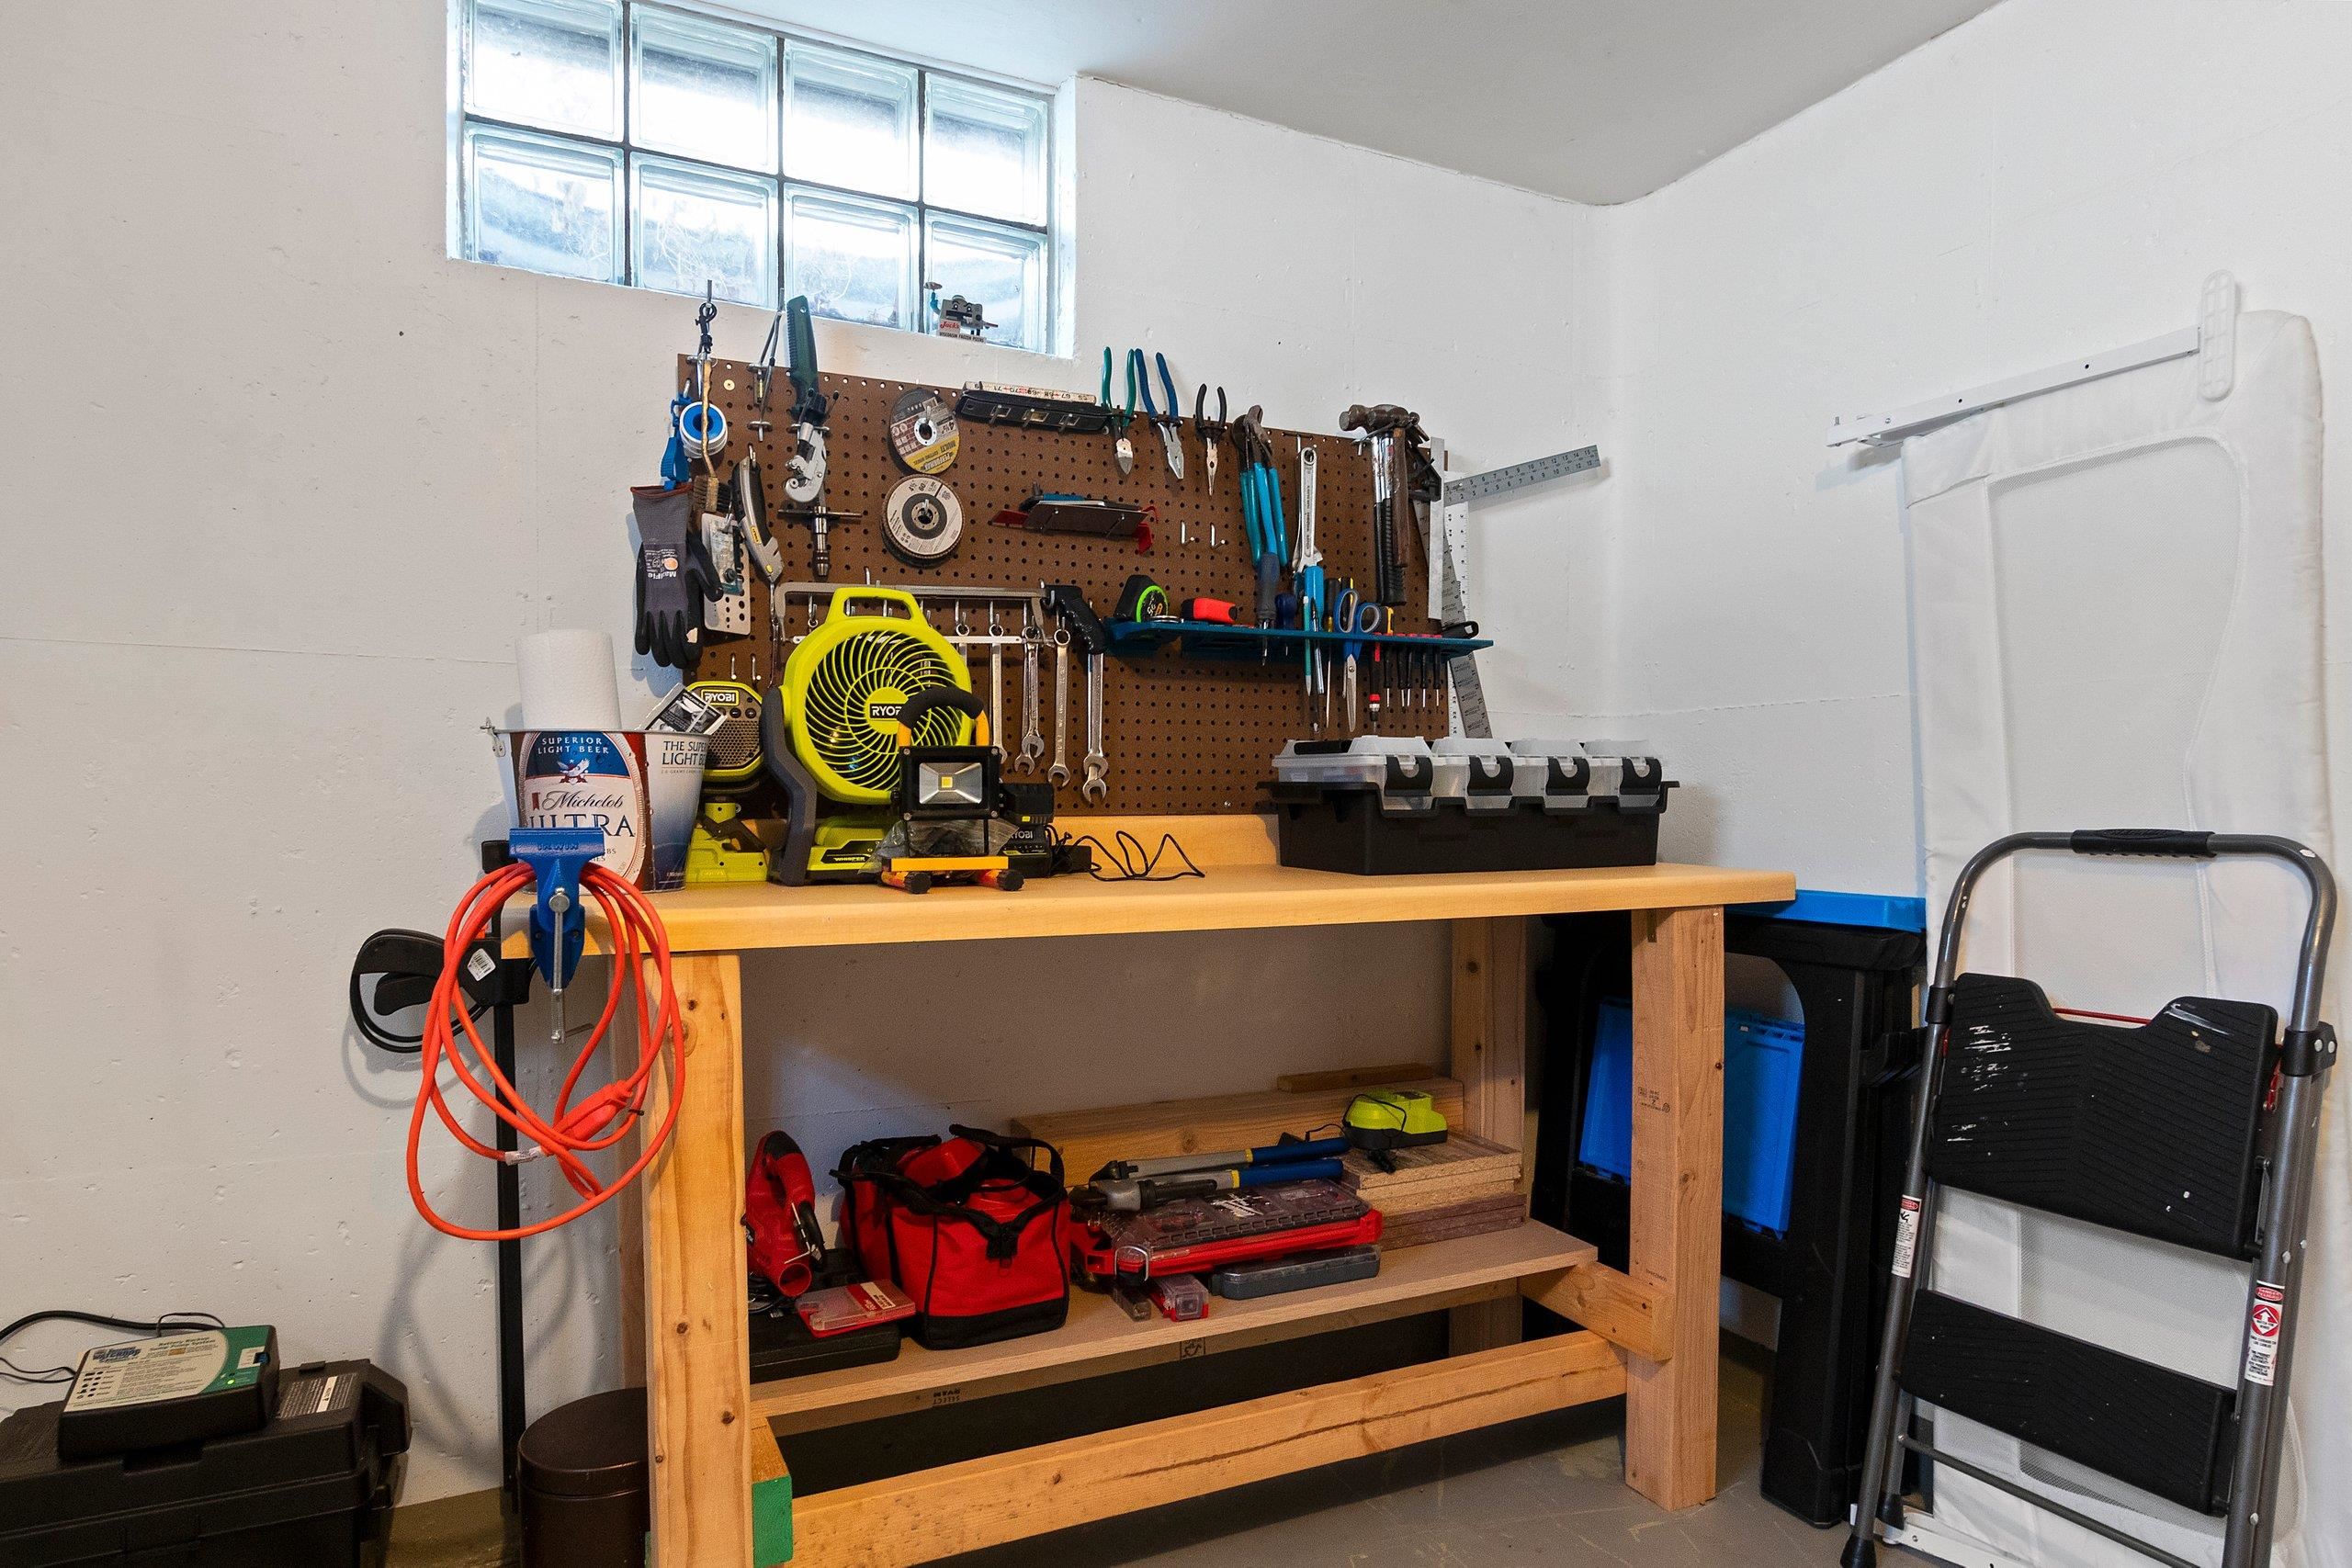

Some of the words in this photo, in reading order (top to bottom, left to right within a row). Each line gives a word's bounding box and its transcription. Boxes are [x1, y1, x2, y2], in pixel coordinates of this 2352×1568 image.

[704, 693, 735, 702] RYOBI
[542, 737, 602, 745] SUPERIOR
[663, 740, 684, 751] THE
[538, 745, 570, 755] LIGHT
[579, 745, 610, 754] BEER
[662, 752, 699, 766] LIGHT
[541, 790, 625, 811] Michelob
